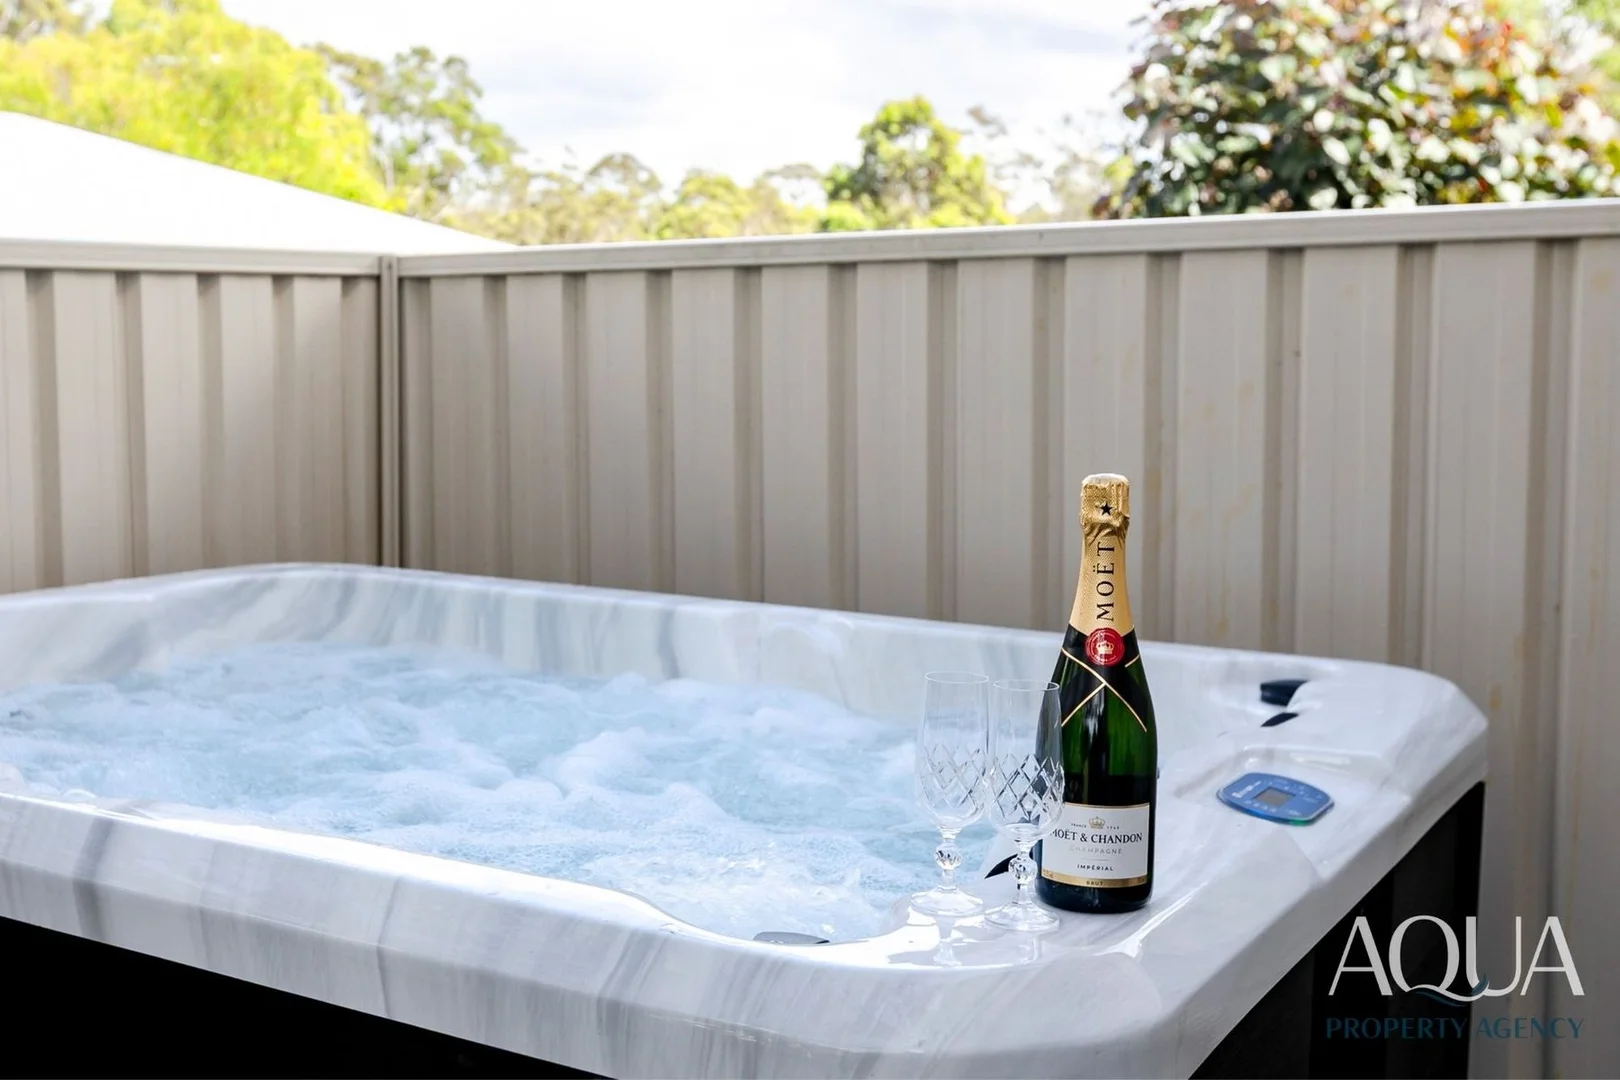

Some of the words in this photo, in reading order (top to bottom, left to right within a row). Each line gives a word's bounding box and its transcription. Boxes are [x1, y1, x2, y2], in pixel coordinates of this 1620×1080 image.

[1093, 541, 1115, 622] MOËT
[1080, 833, 1088, 842] &
[1091, 832, 1143, 844] CHANDON
[1069, 845, 1122, 855] CHAMPAGNE
[1077, 863, 1114, 872] IMPÉRIAL
